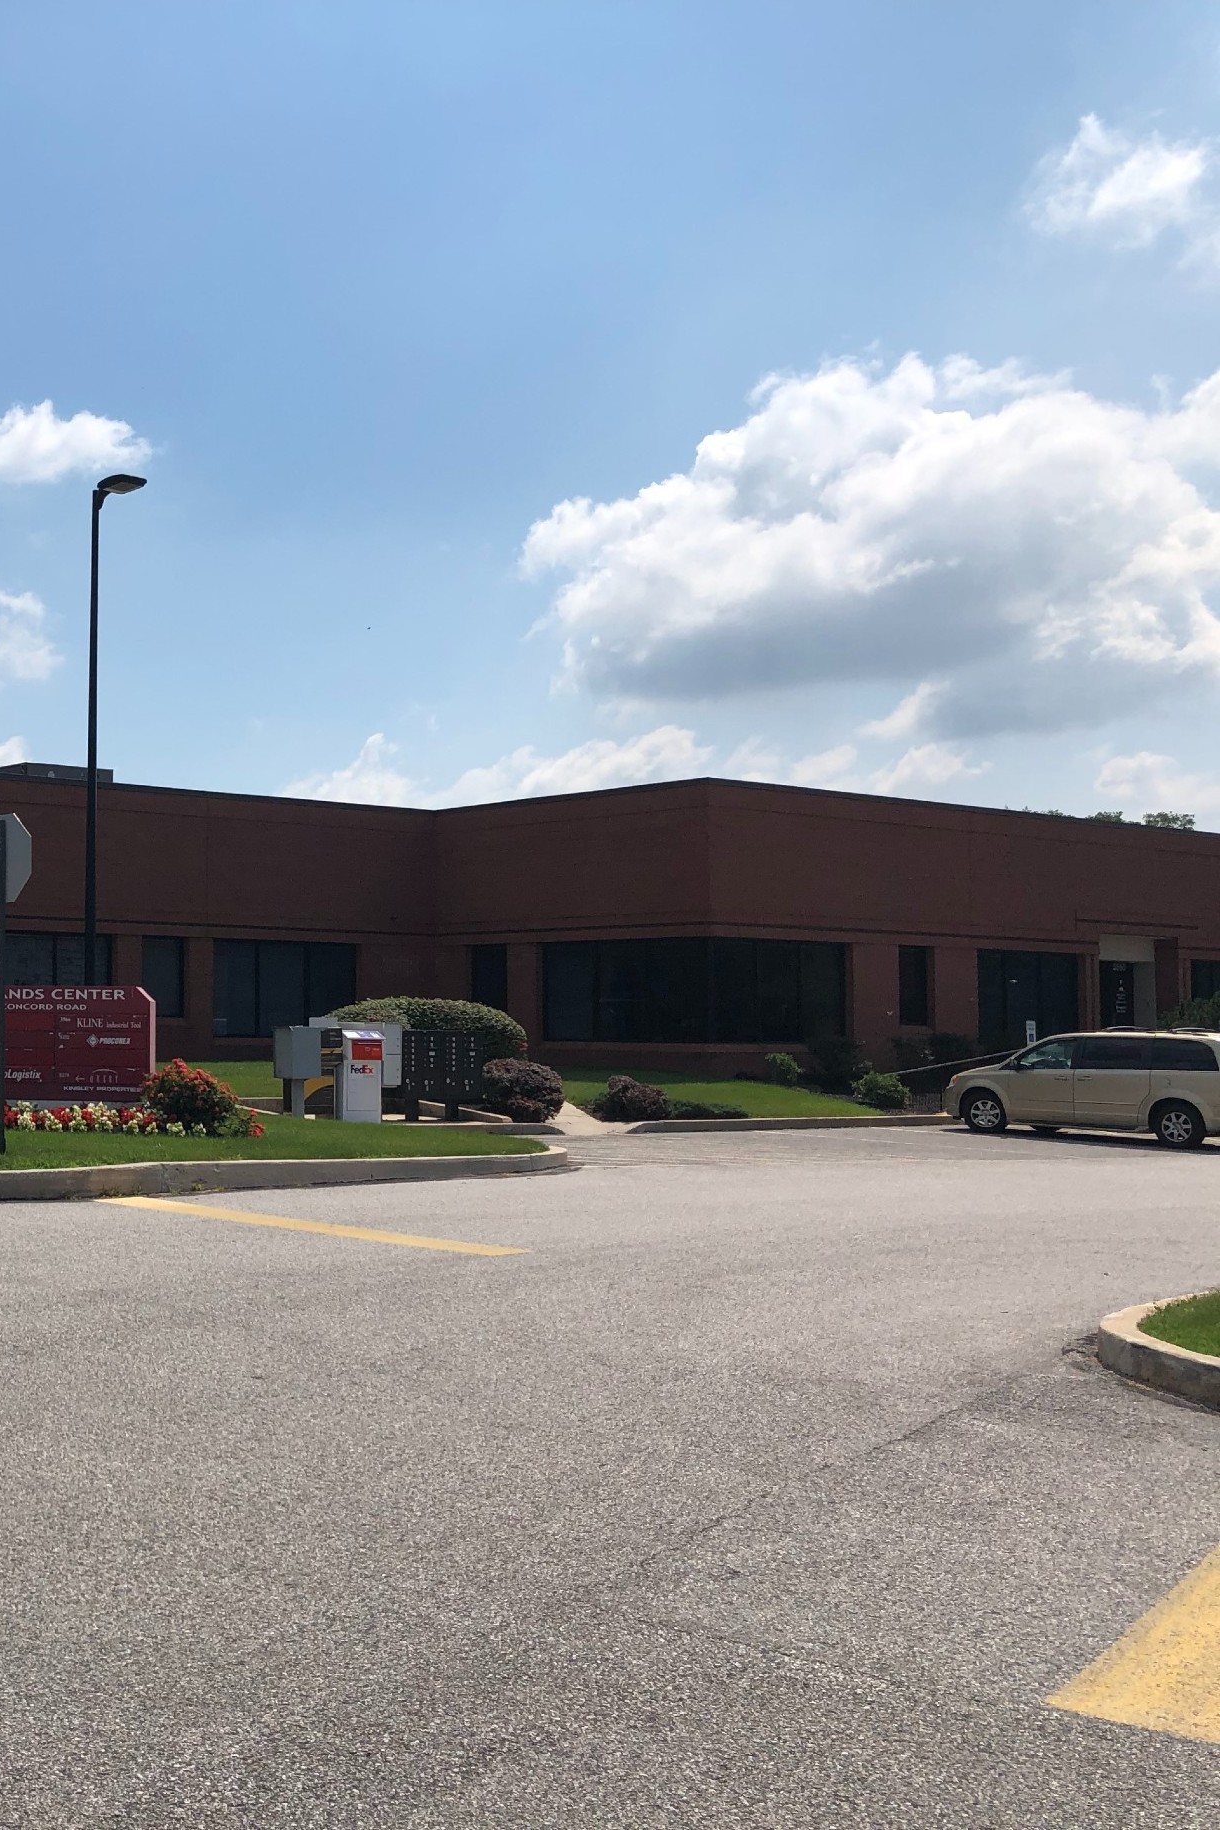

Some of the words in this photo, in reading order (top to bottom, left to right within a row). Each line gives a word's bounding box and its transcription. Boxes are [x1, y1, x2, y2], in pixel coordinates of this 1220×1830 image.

[51, 988, 126, 1001] CENTER
[56, 1003, 87, 1012] ROAD
[76, 1017, 103, 1028] KLINE
[130, 1021, 141, 1029] Tool
[350, 1064, 374, 1074] FedEx
